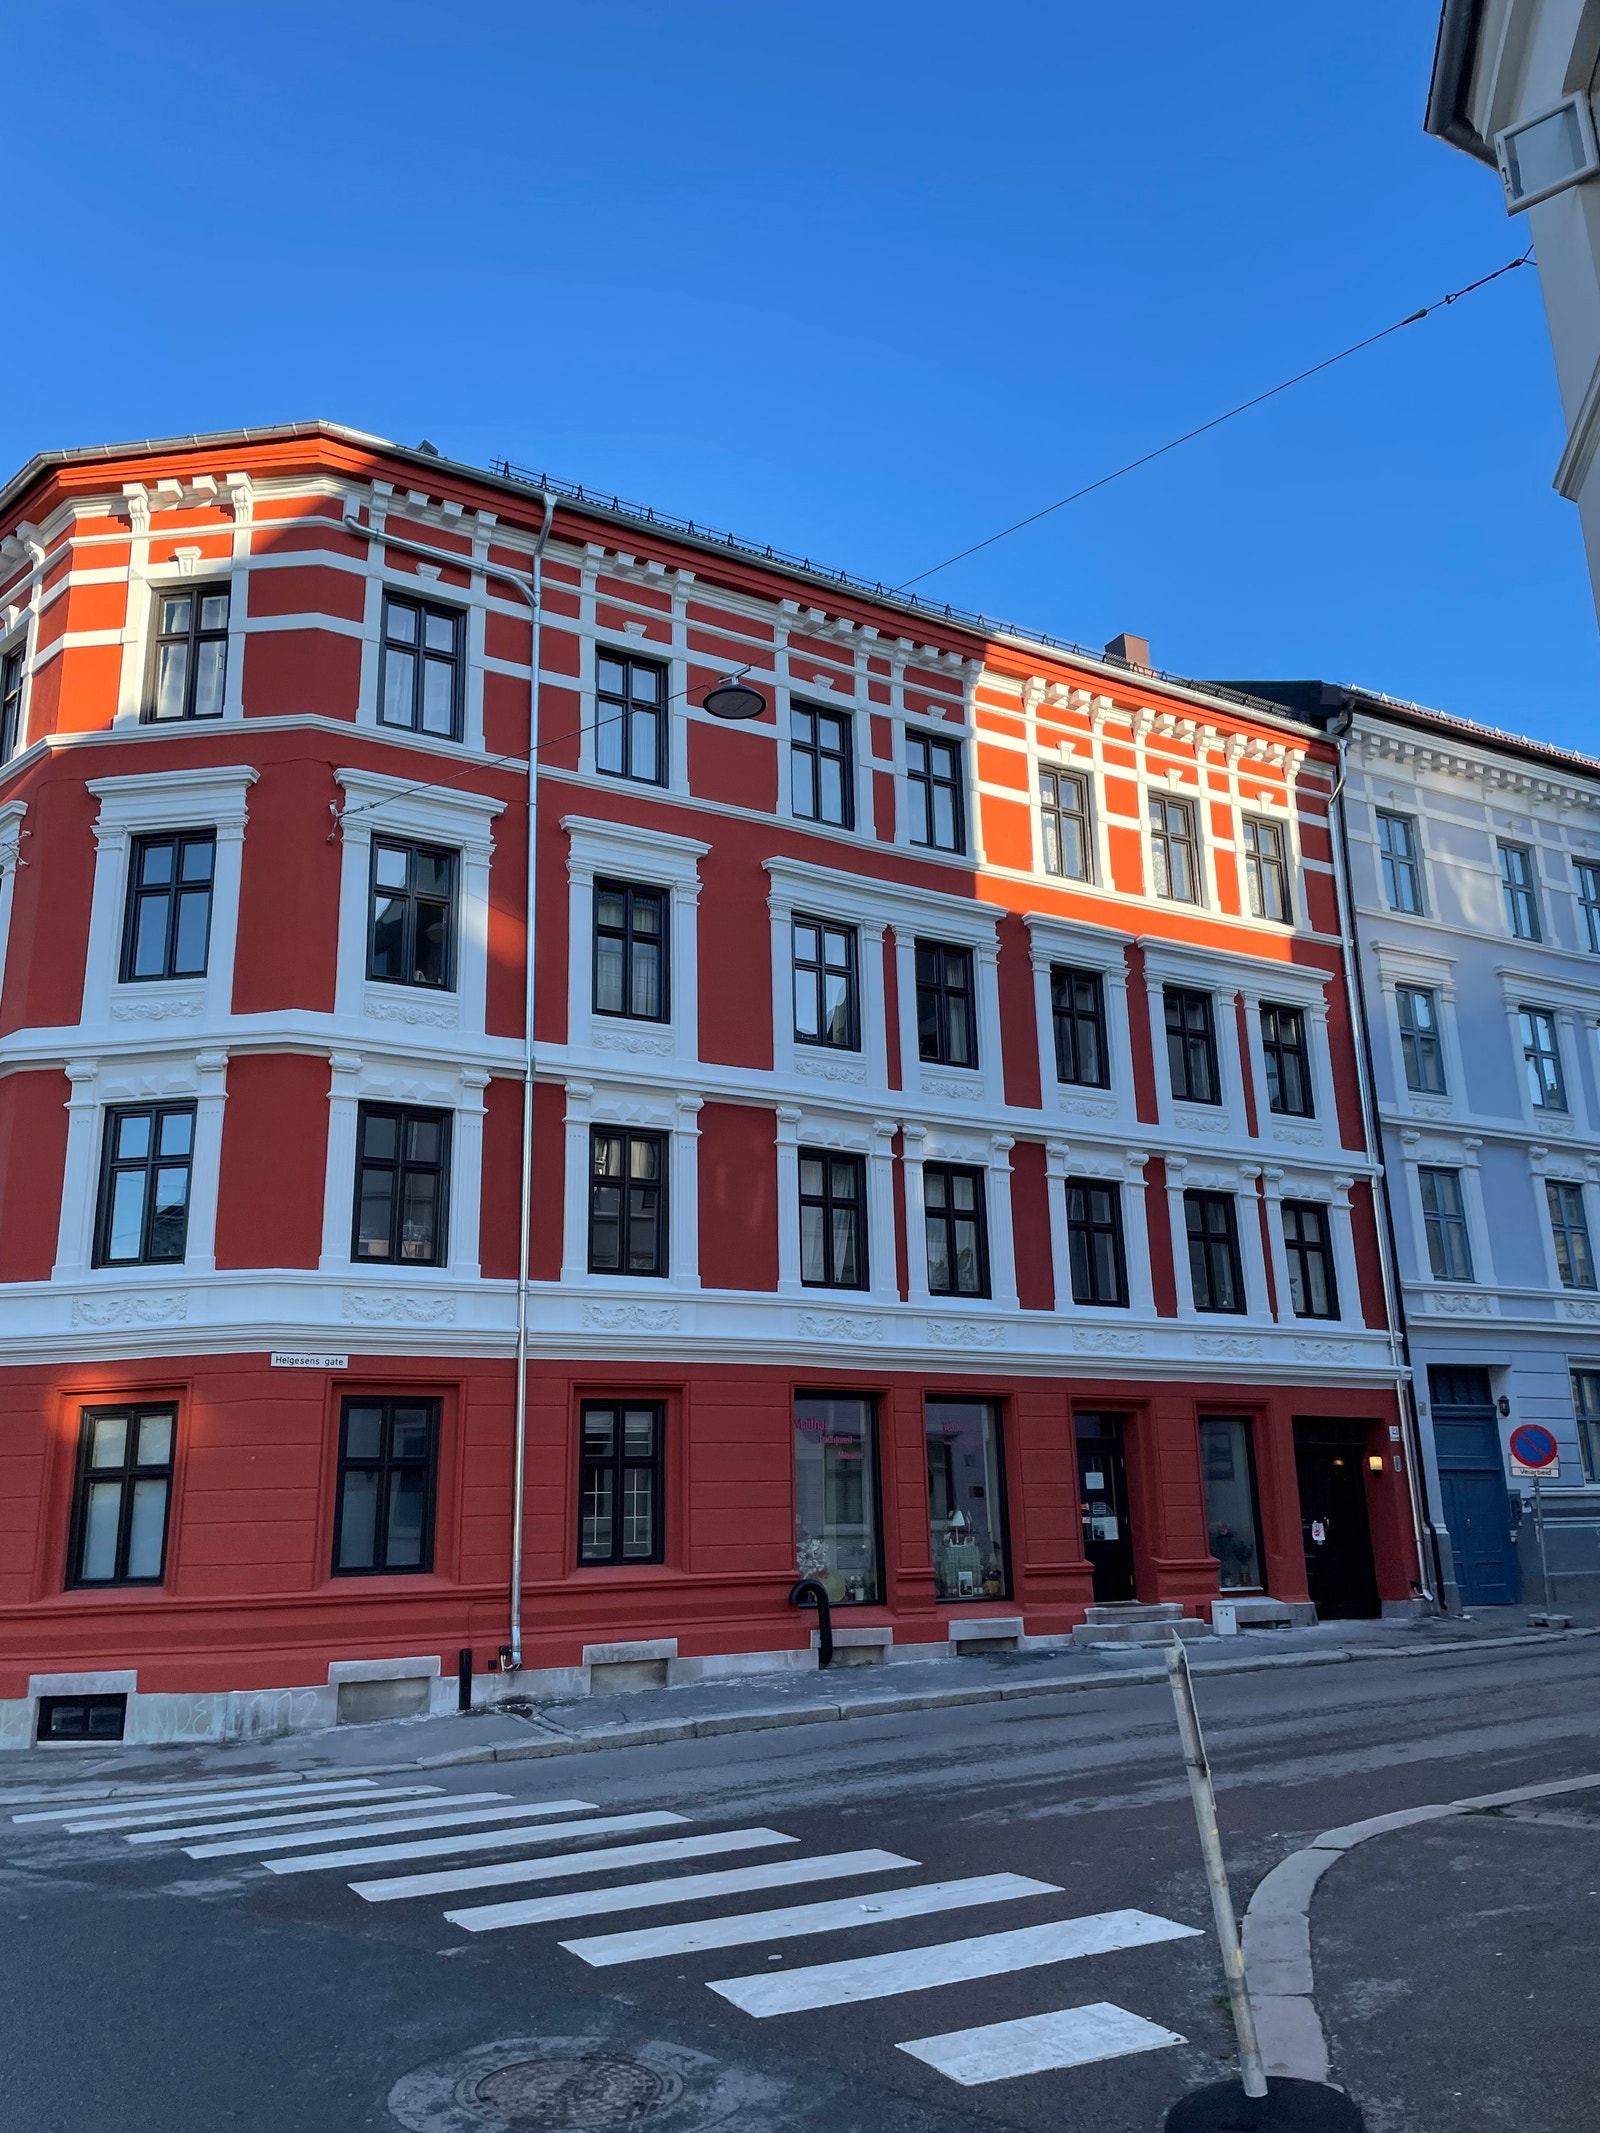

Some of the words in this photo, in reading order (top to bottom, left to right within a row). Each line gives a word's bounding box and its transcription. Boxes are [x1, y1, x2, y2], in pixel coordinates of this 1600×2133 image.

[275, 1355, 320, 1366] Helgesens
[324, 1358, 344, 1367] gate
[1519, 1468, 1552, 1476] Veiarbeid
